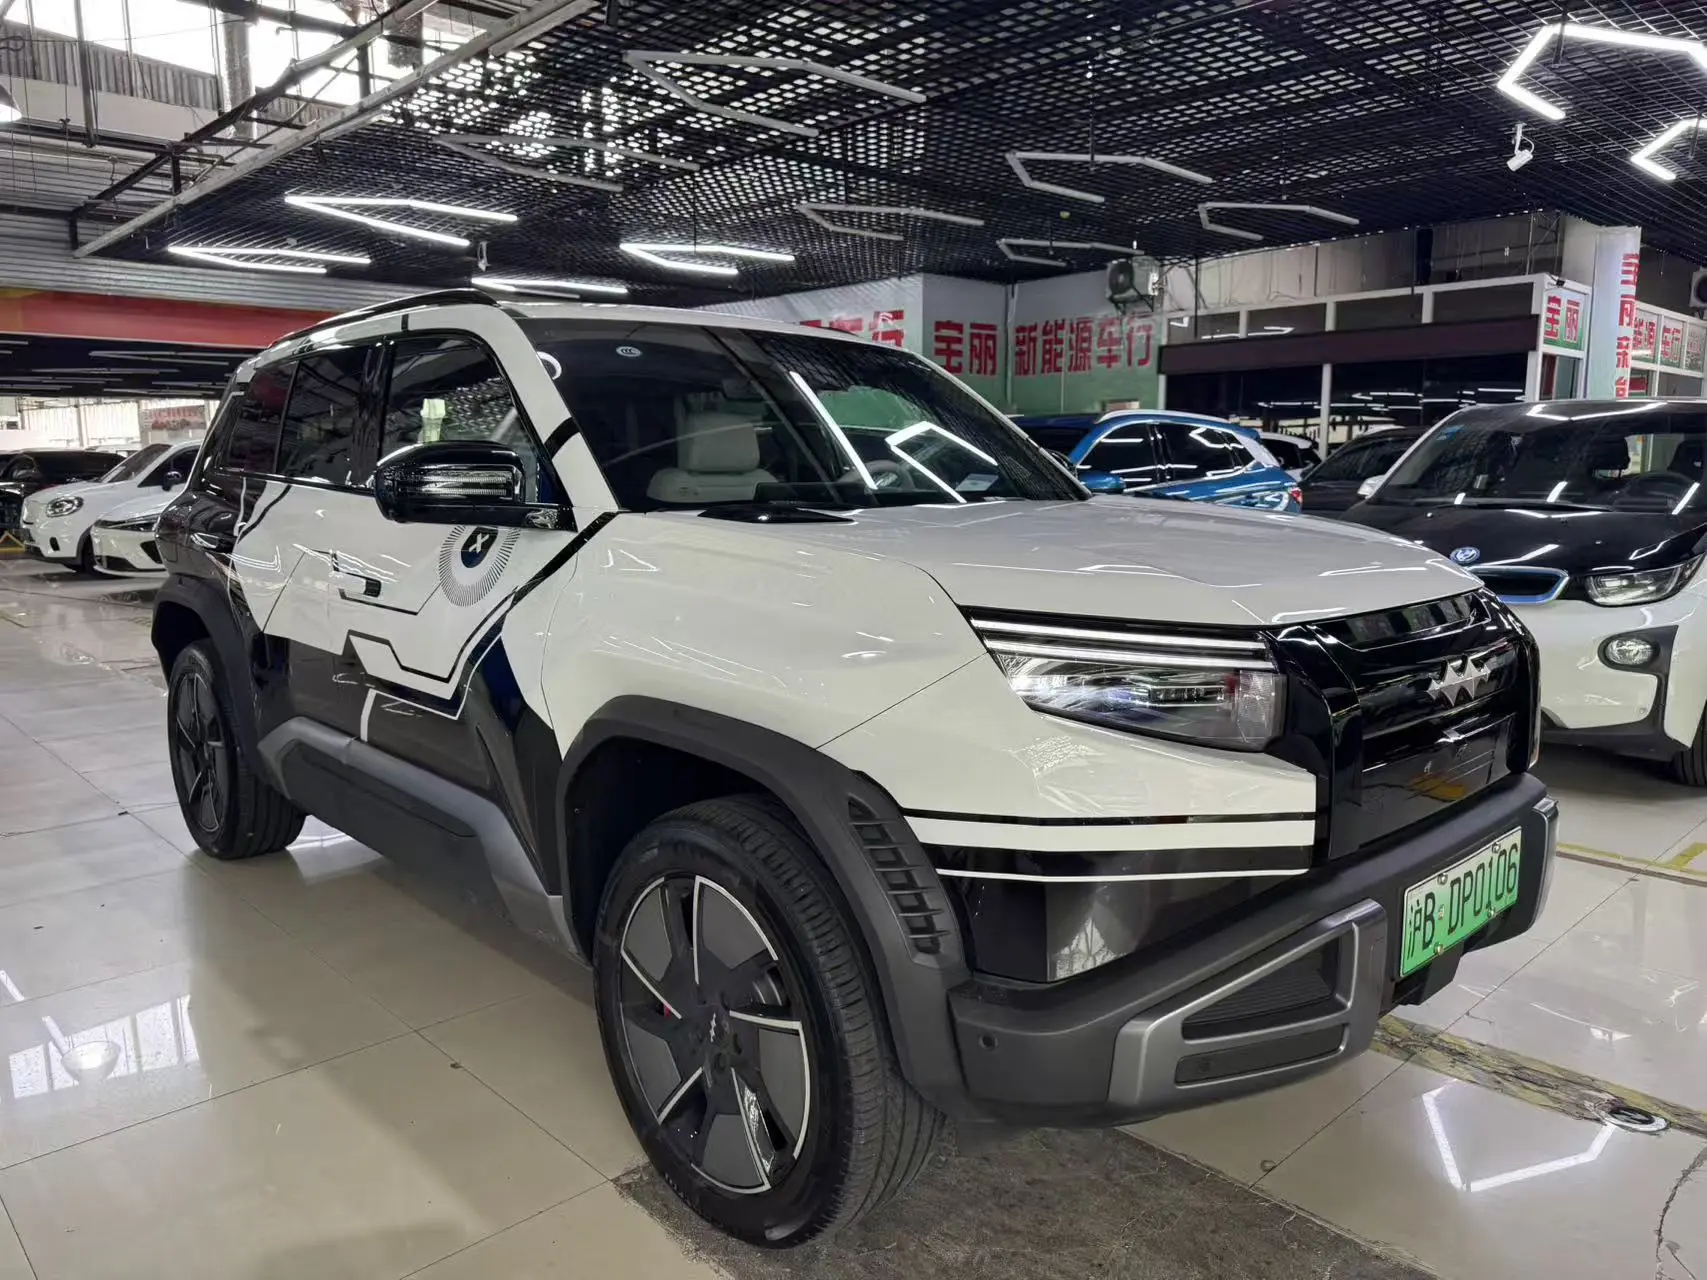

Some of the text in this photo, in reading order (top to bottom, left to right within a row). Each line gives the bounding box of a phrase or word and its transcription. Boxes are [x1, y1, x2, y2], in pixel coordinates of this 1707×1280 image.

[934, 319, 998, 376] 宝丽
[1014, 314, 1153, 376] 新能源车行
[1544, 295, 1580, 342] 宝丽
